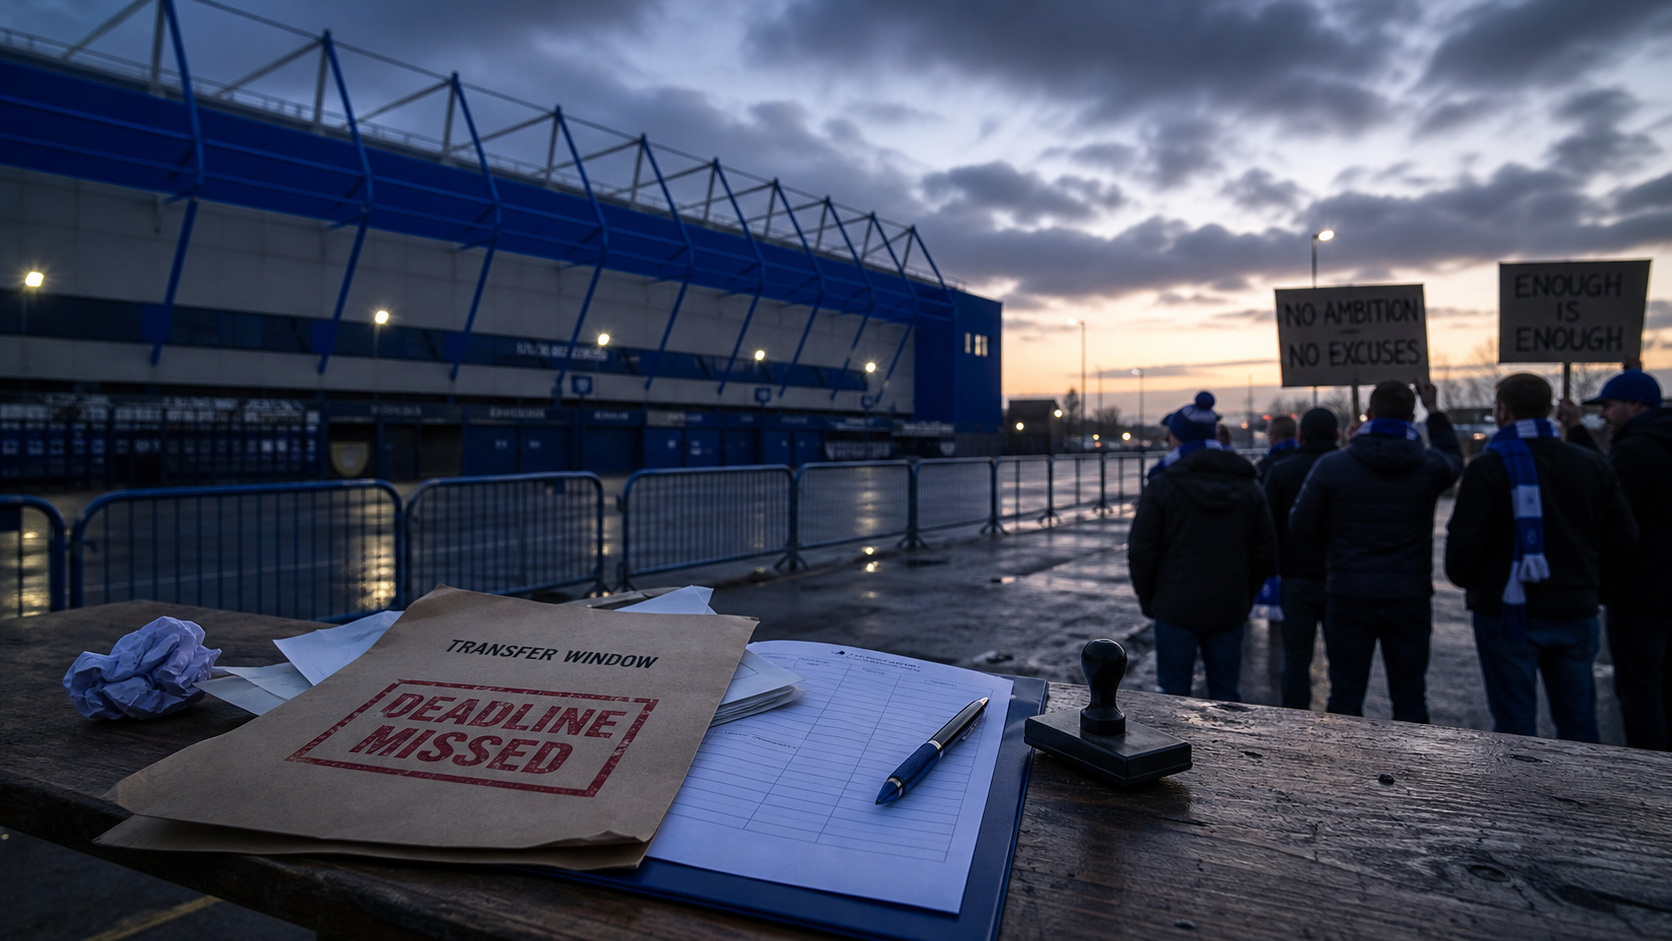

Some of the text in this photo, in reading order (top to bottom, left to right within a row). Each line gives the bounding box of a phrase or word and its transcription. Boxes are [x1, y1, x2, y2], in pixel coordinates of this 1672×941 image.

[1514, 272, 1623, 299] ENOUGH
[1284, 297, 1418, 327] NO AMBITION
[1556, 301, 1581, 323] IS
[1288, 338, 1421, 368] NO EXCUSES
[1515, 326, 1624, 352] ENOUGH
[446, 639, 659, 668] TRANSFER WINDOW
[383, 693, 628, 739] DEADLINE
[348, 725, 573, 774] MISSED
